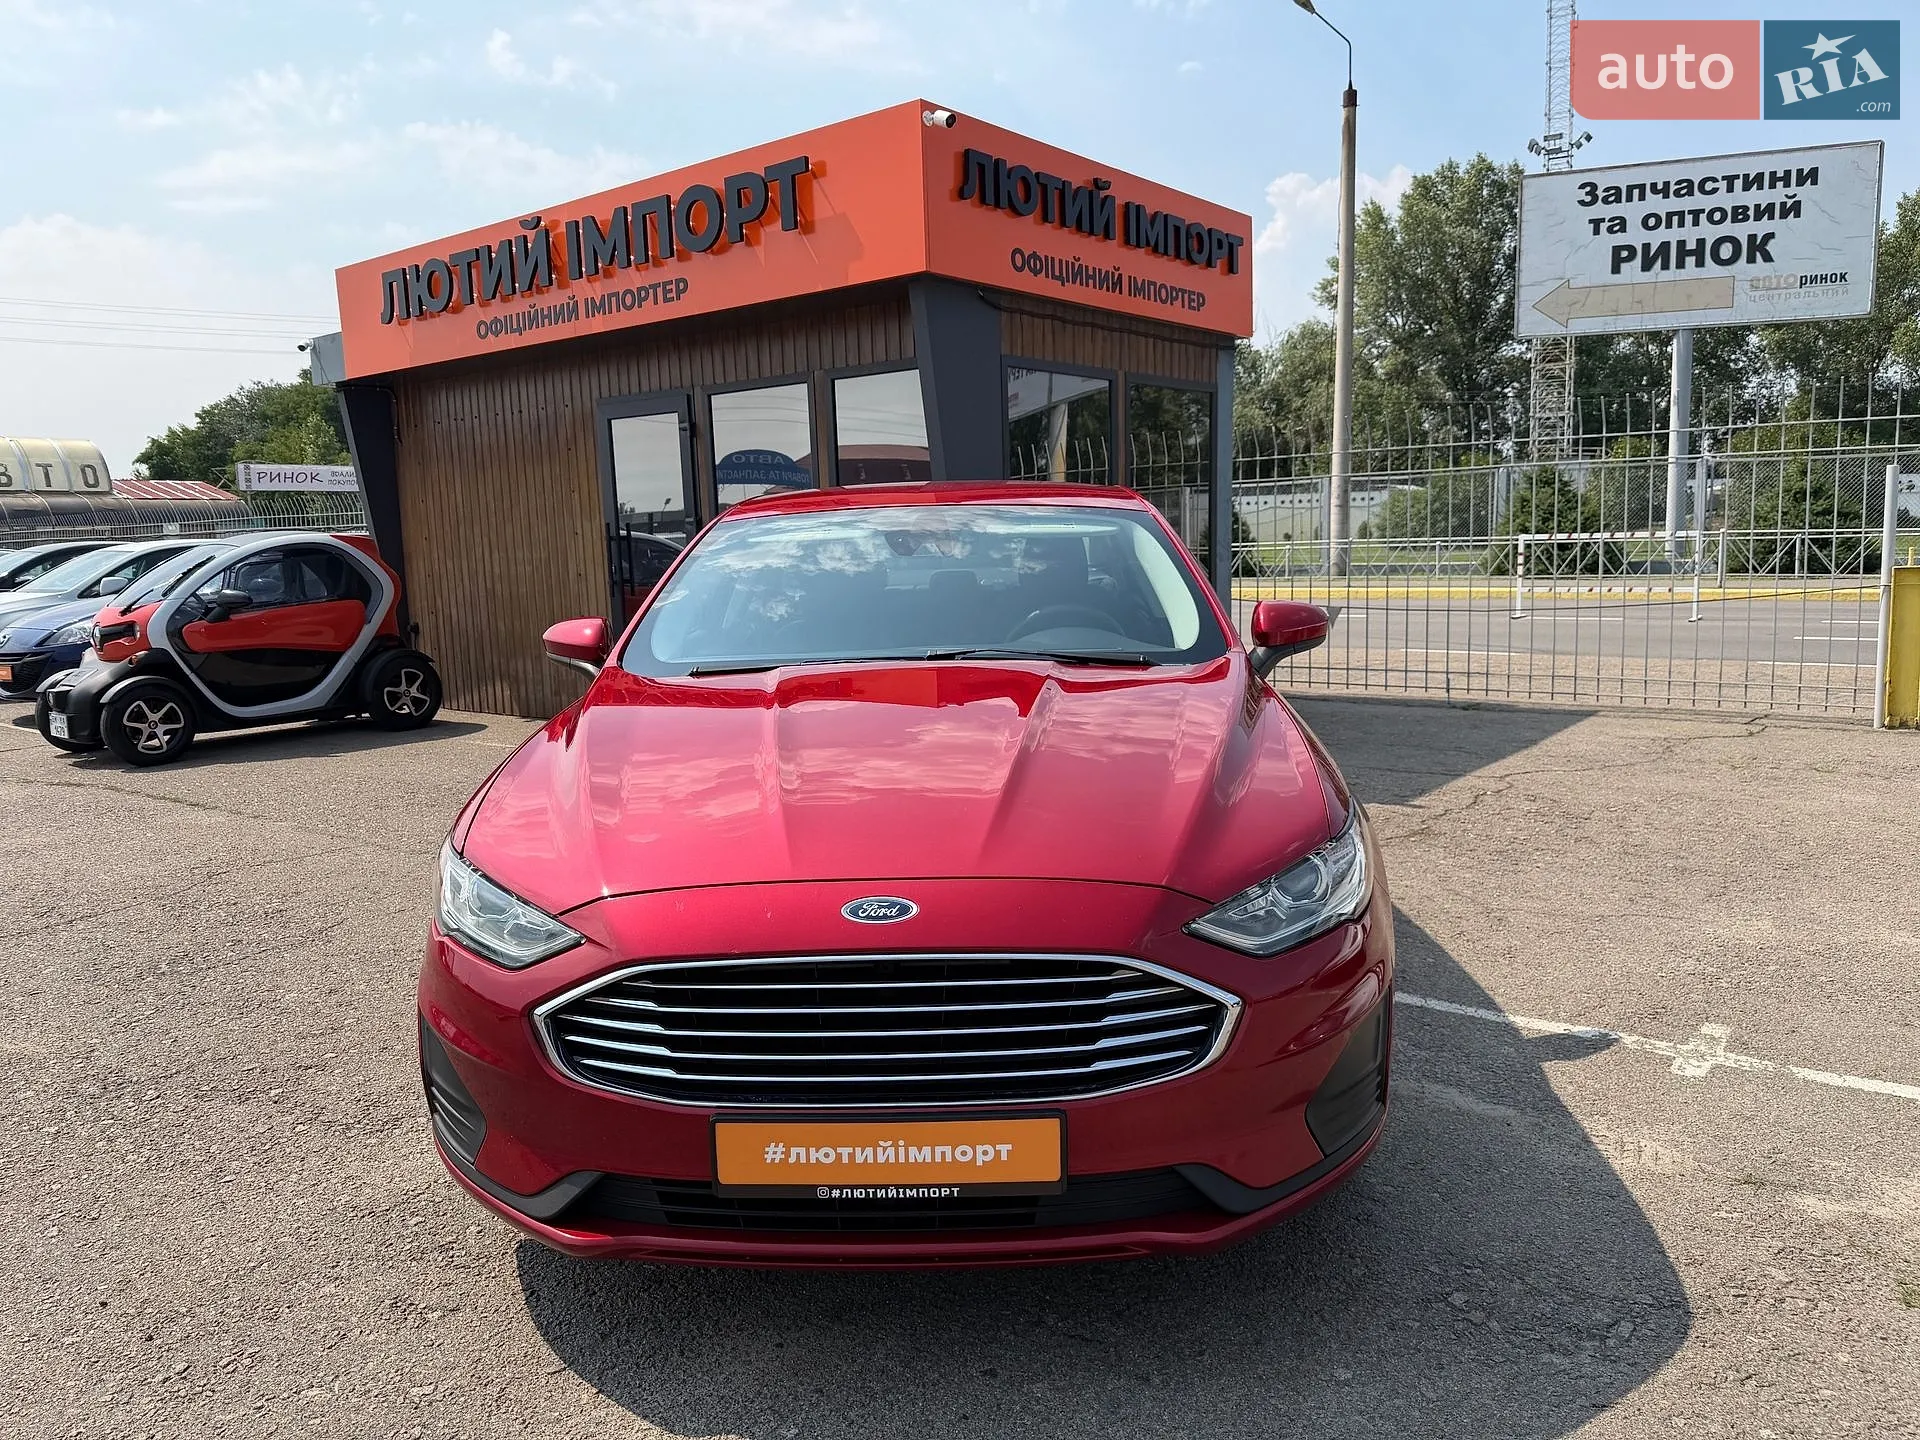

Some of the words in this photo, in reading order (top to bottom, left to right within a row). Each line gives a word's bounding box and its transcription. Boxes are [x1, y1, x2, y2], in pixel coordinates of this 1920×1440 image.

[1576, 165, 1820, 208] Запчастини
[959, 148, 1117, 241] ЛЮТИЙ
[1125, 200, 1244, 275] ІМПОРТ
[1588, 214, 1627, 236] та
[1641, 193, 1801, 232] оптовий
[380, 215, 553, 325] ЛЮТИЙ
[565, 155, 813, 281] ІМПОРТ
[1610, 231, 1775, 275] РИНОК
[1010, 247, 1123, 295] ОФІЦІЙНИЙ
[1128, 275, 1206, 312] ІМПОРТЕР
[476, 294, 580, 340] ОФІЦІЙНИЙ
[583, 277, 689, 320] ІМПОРТЕР
[256, 471, 324, 484] РИНОК
[858, 902, 901, 917] Ford
[763, 1139, 1013, 1166] #лютийімпорт
[831, 1186, 960, 1199] #ЛЮТИЙІМПОРТ
